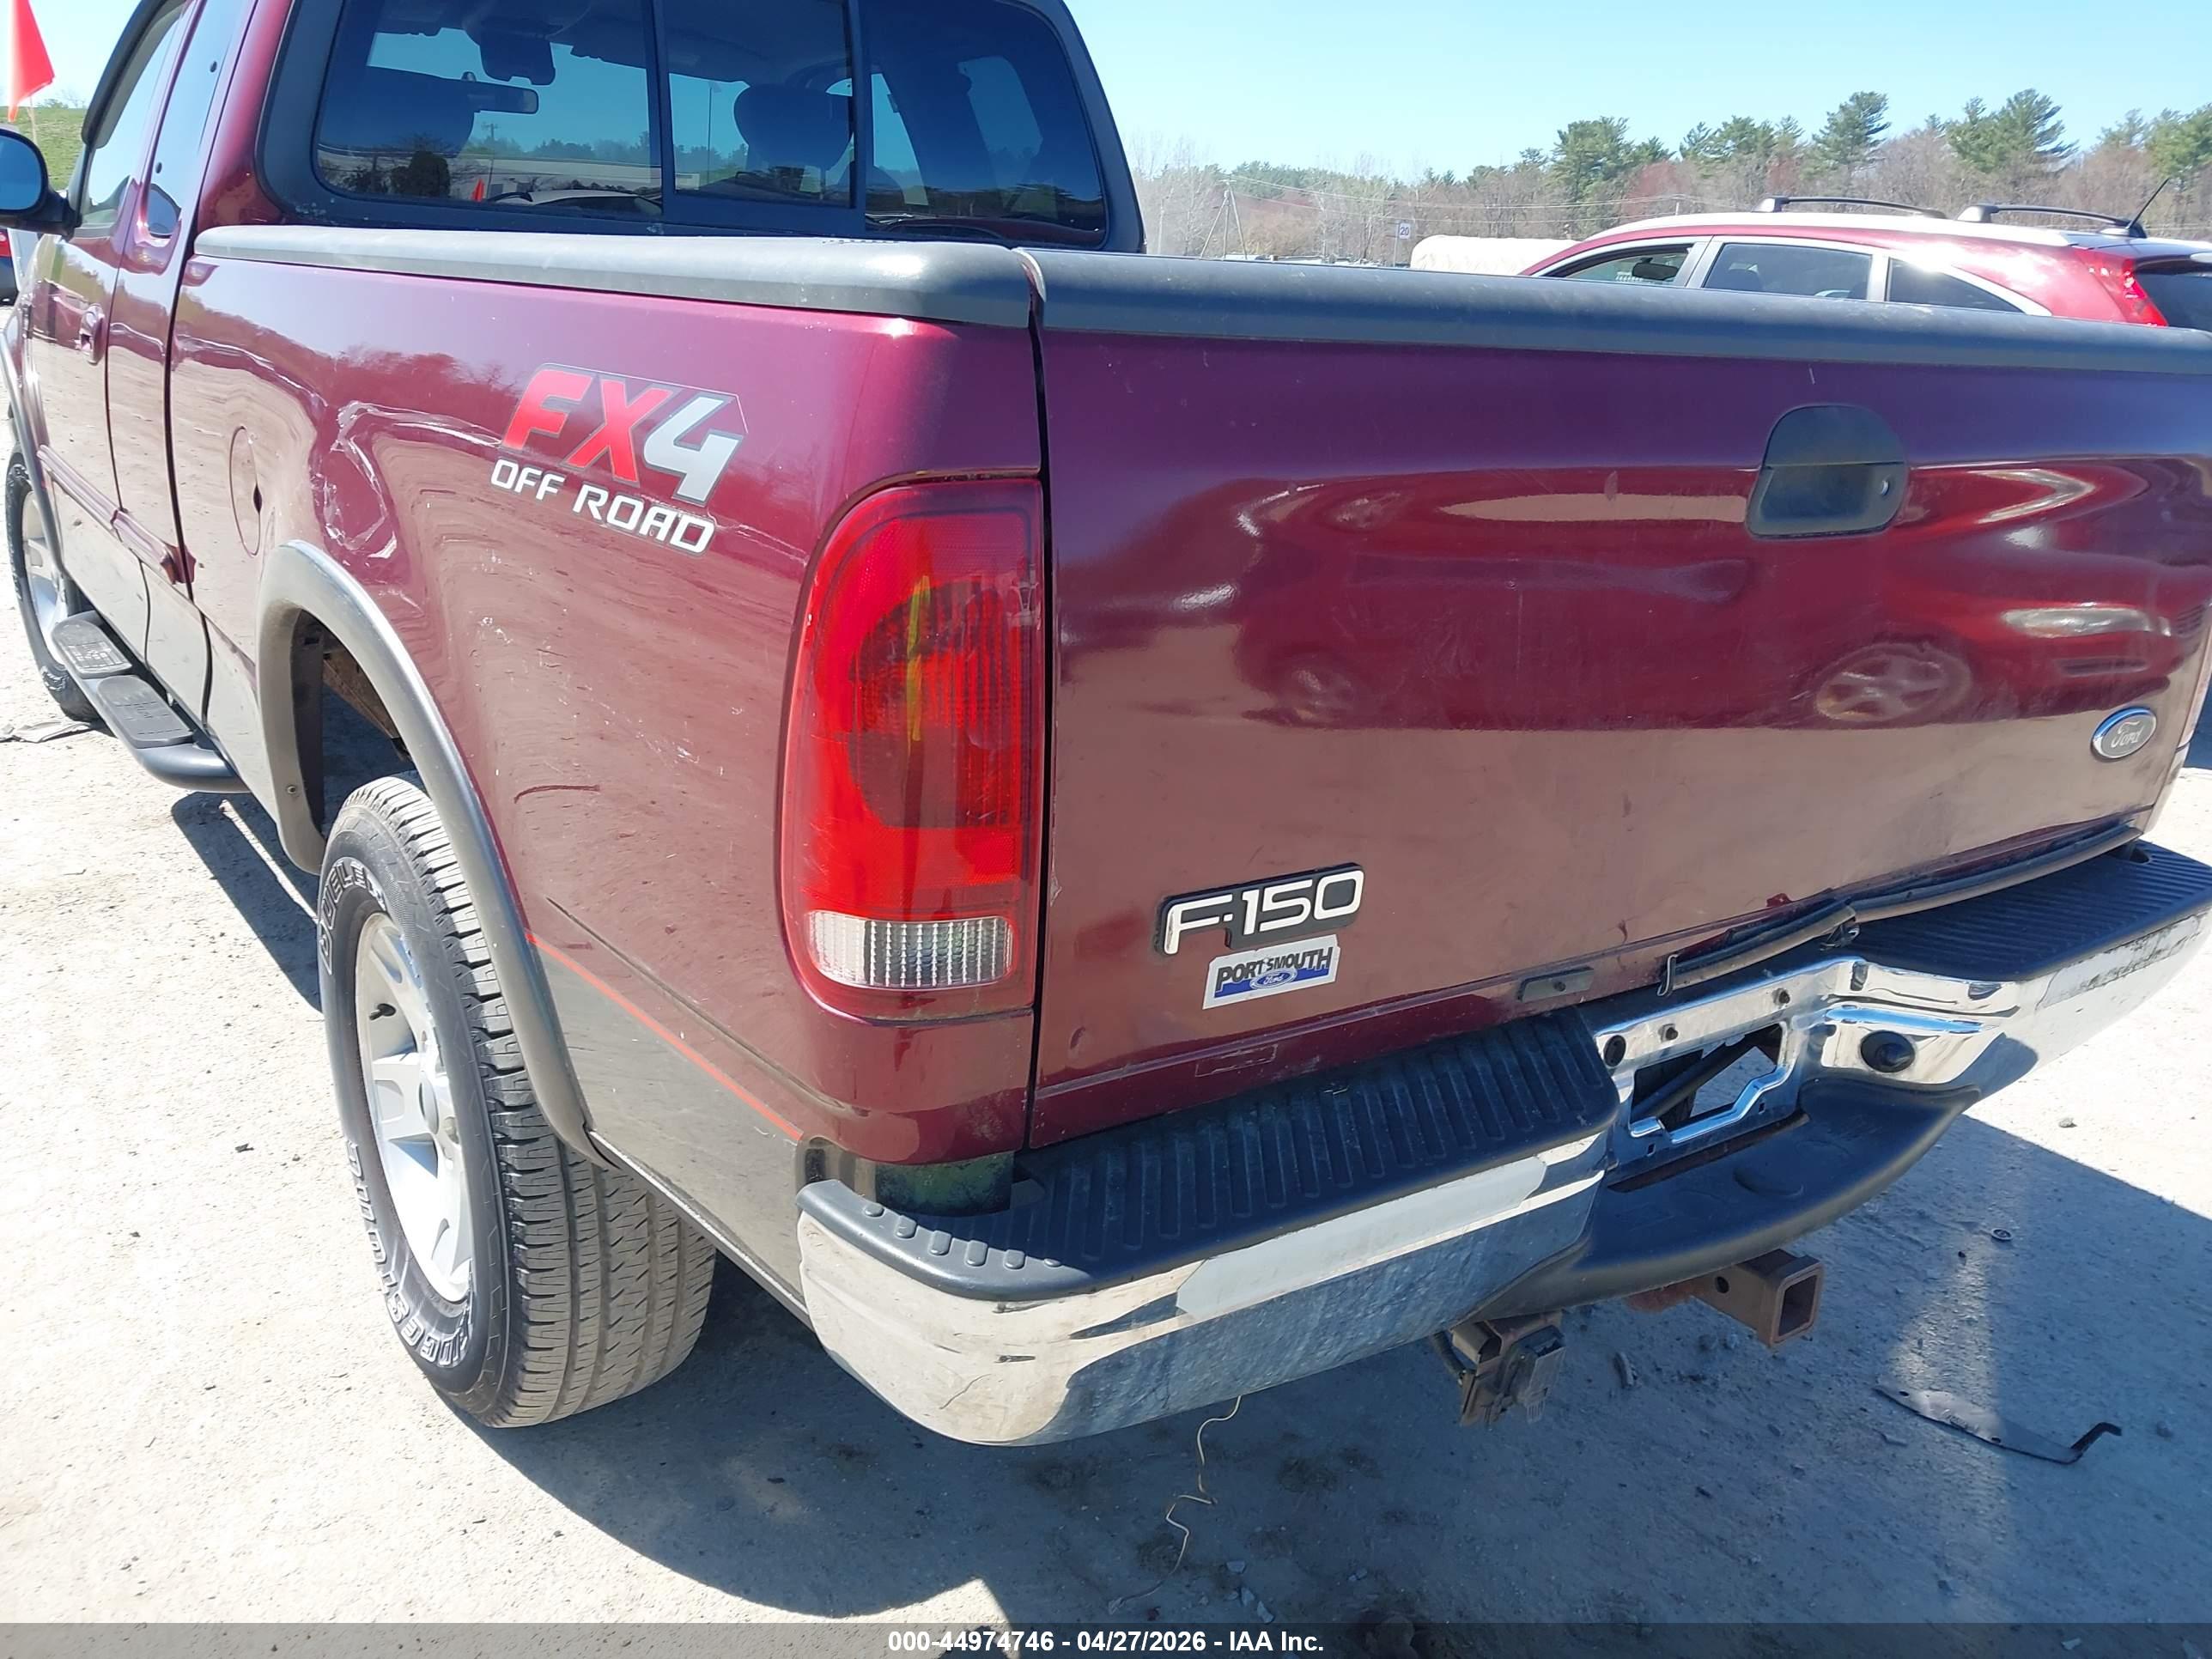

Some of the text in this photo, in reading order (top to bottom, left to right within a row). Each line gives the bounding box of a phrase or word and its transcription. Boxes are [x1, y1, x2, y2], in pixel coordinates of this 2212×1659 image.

[501, 368, 740, 504] FX4
[489, 458, 715, 554] OFF ROAD
[2110, 720, 2145, 749] Ford
[1163, 869, 1365, 955] F-150
[1214, 946, 1334, 994] PORTSMOUTH
[1262, 973, 1288, 985] Ford
